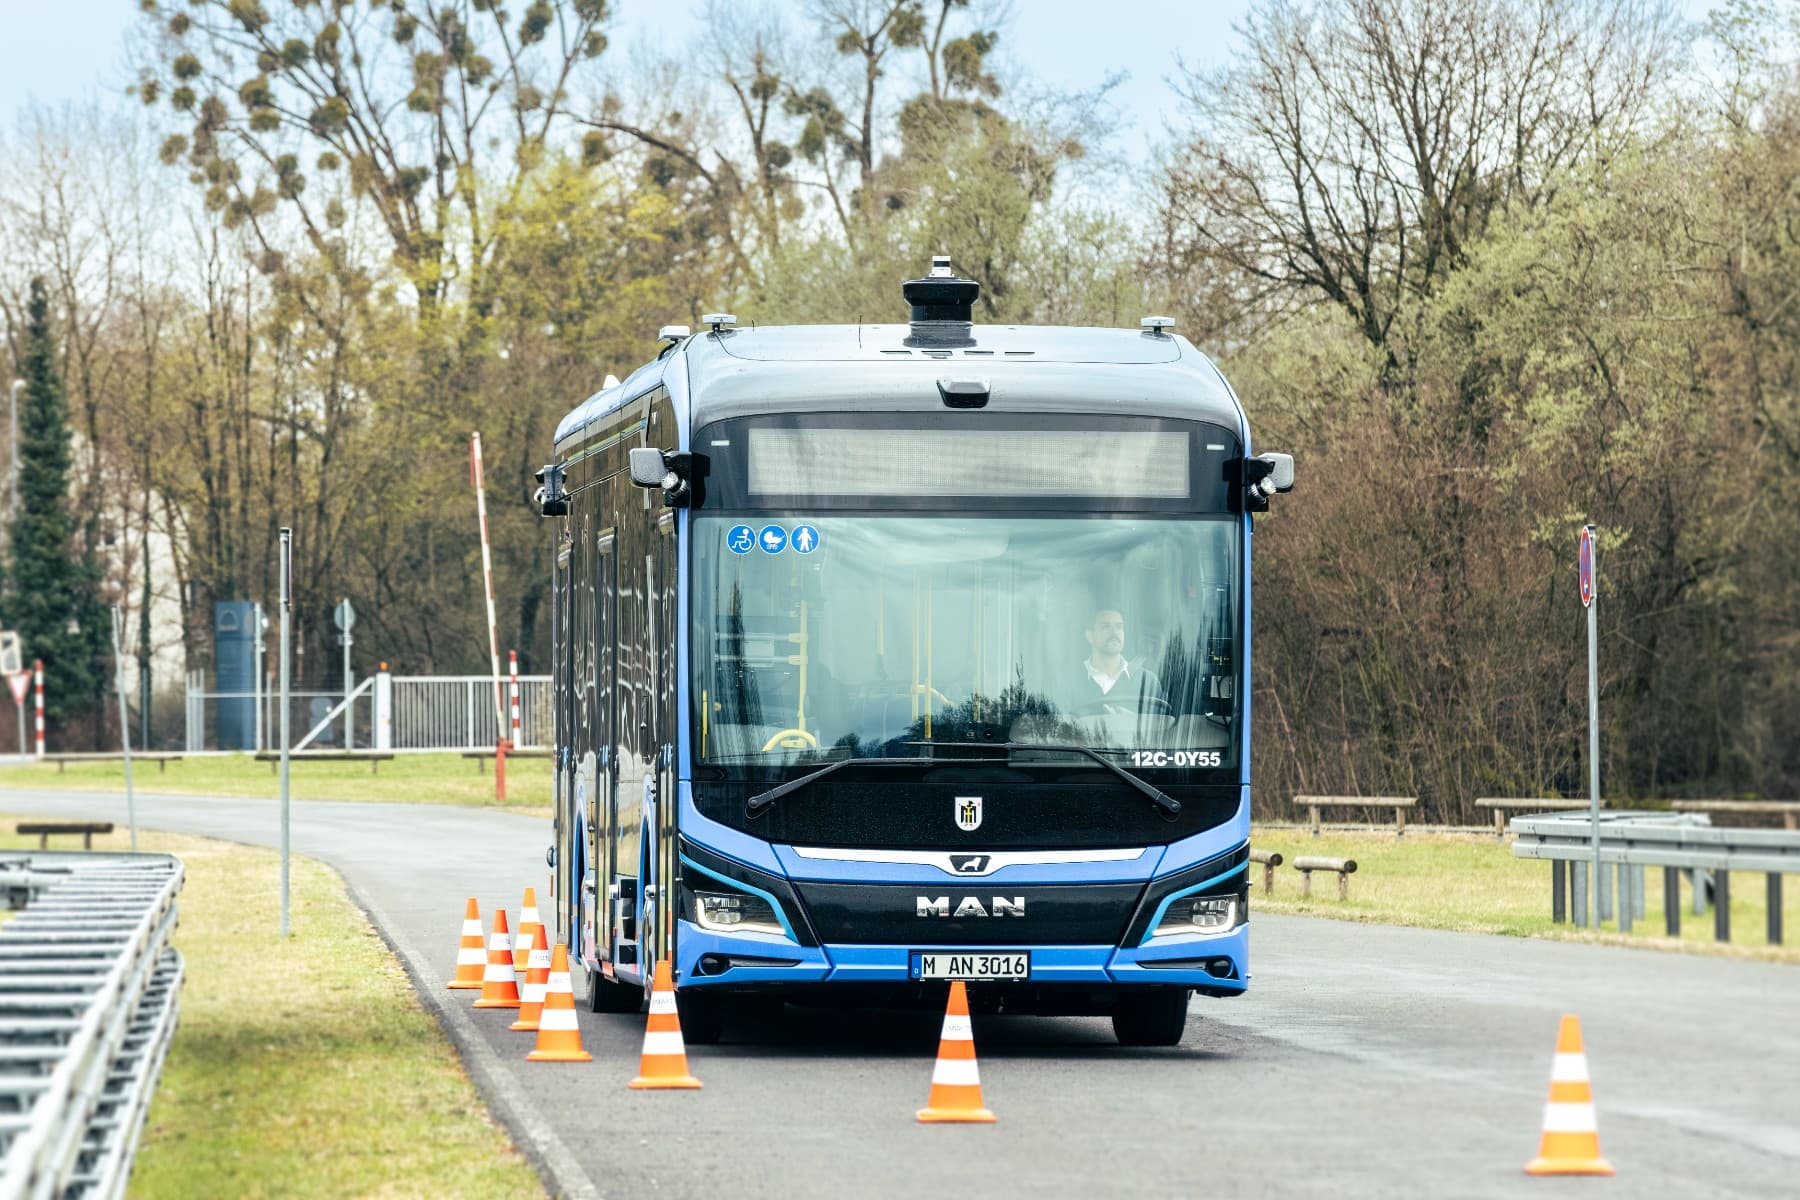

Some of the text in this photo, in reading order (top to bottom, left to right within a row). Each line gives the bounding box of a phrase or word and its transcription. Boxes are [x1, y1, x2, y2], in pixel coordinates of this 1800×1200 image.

[1131, 751, 1221, 767] 12C-0Y55
[916, 896, 1025, 917] MAN
[923, 957, 1025, 975] M AN 3016
